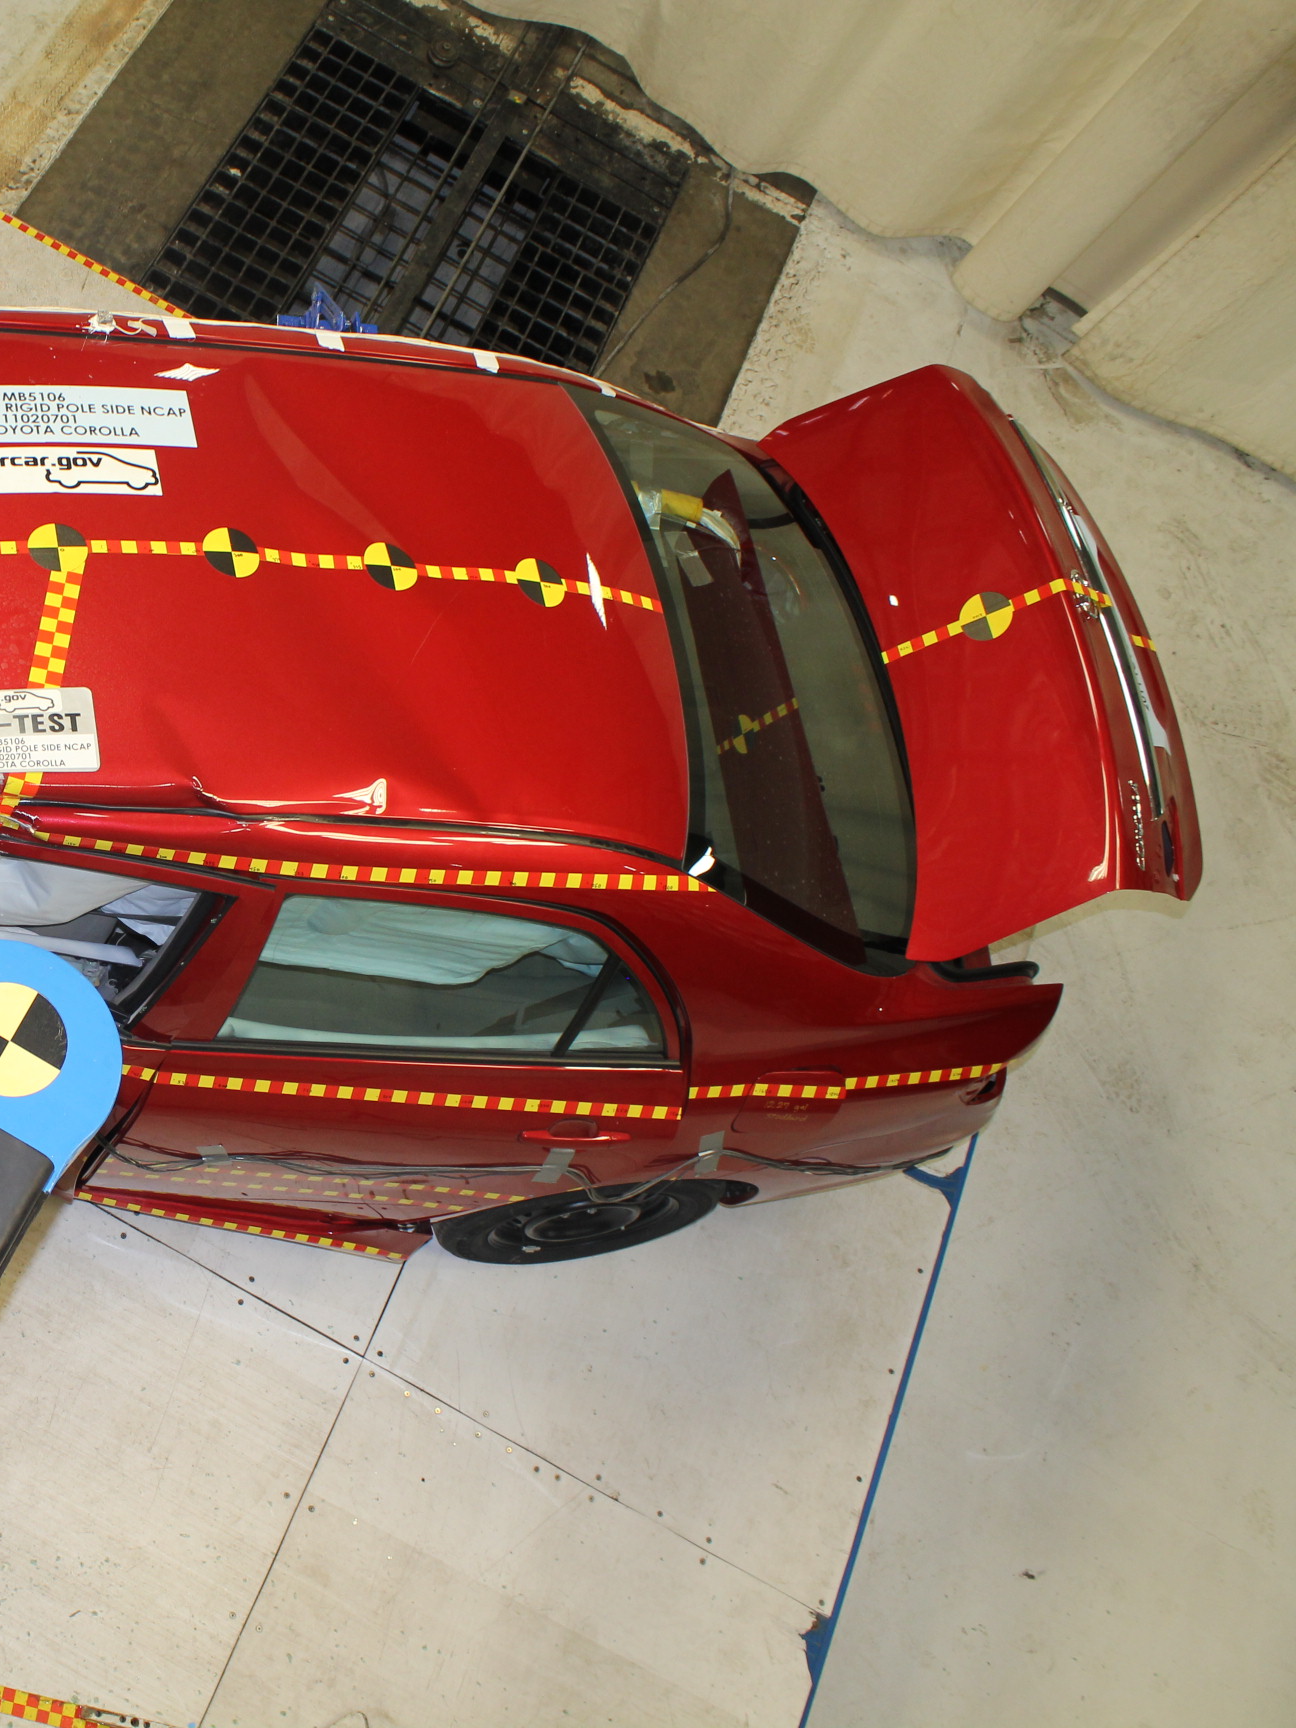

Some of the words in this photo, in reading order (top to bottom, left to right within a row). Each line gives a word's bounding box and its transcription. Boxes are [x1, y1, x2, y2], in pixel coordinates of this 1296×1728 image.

[2, 391, 66, 402] MB5106
[5, 402, 51, 413] RIGID
[56, 403, 97, 414] POLE
[101, 404, 136, 416] SIDE
[140, 405, 187, 418] NCAP
[2, 413, 78, 424] 11020701
[60, 425, 140, 438] COROLLA
[15, 744, 39, 753] POLE
[41, 743, 62, 752] SIDE
[64, 742, 92, 751] NCAP
[20, 759, 66, 768] COROLLA
